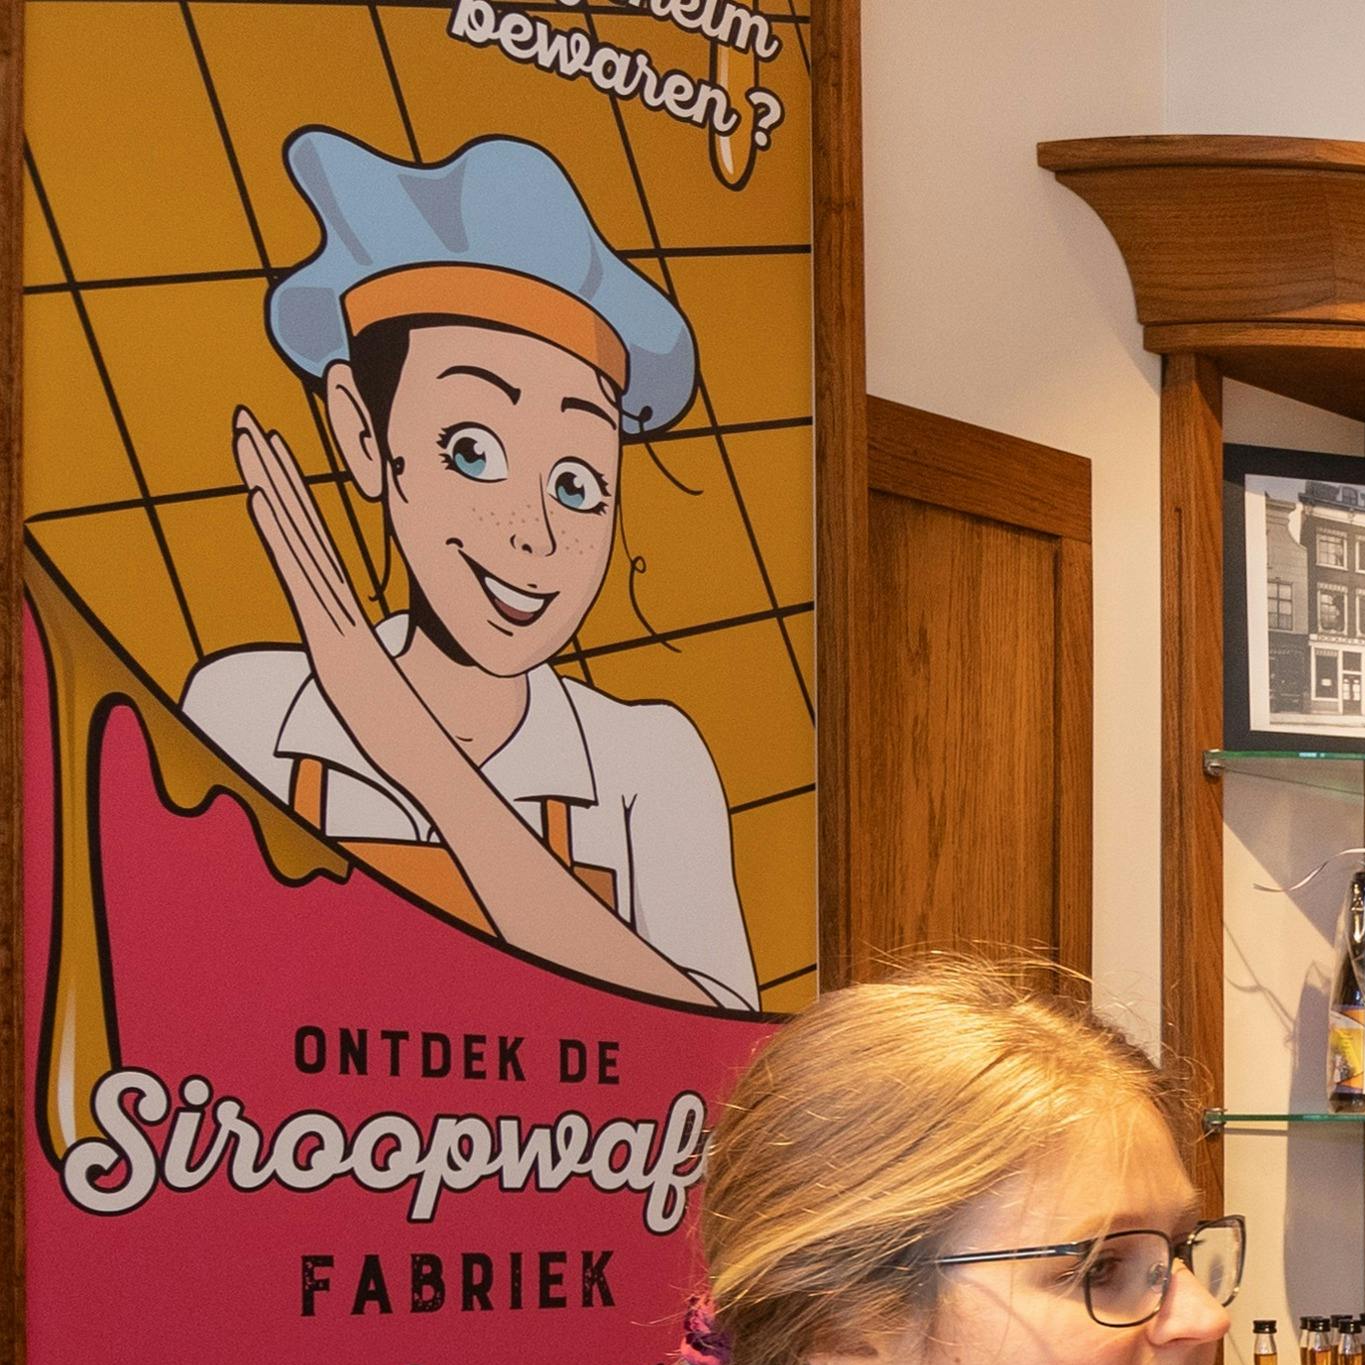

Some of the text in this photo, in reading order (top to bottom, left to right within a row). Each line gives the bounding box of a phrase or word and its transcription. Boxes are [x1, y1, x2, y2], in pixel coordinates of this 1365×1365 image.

[450, 0, 785, 147] bewaren ?
[294, 1026, 621, 1085] ONTDEK DE
[64, 1071, 708, 1233] Siroopwaf
[300, 1251, 616, 1317] FABRIEK
